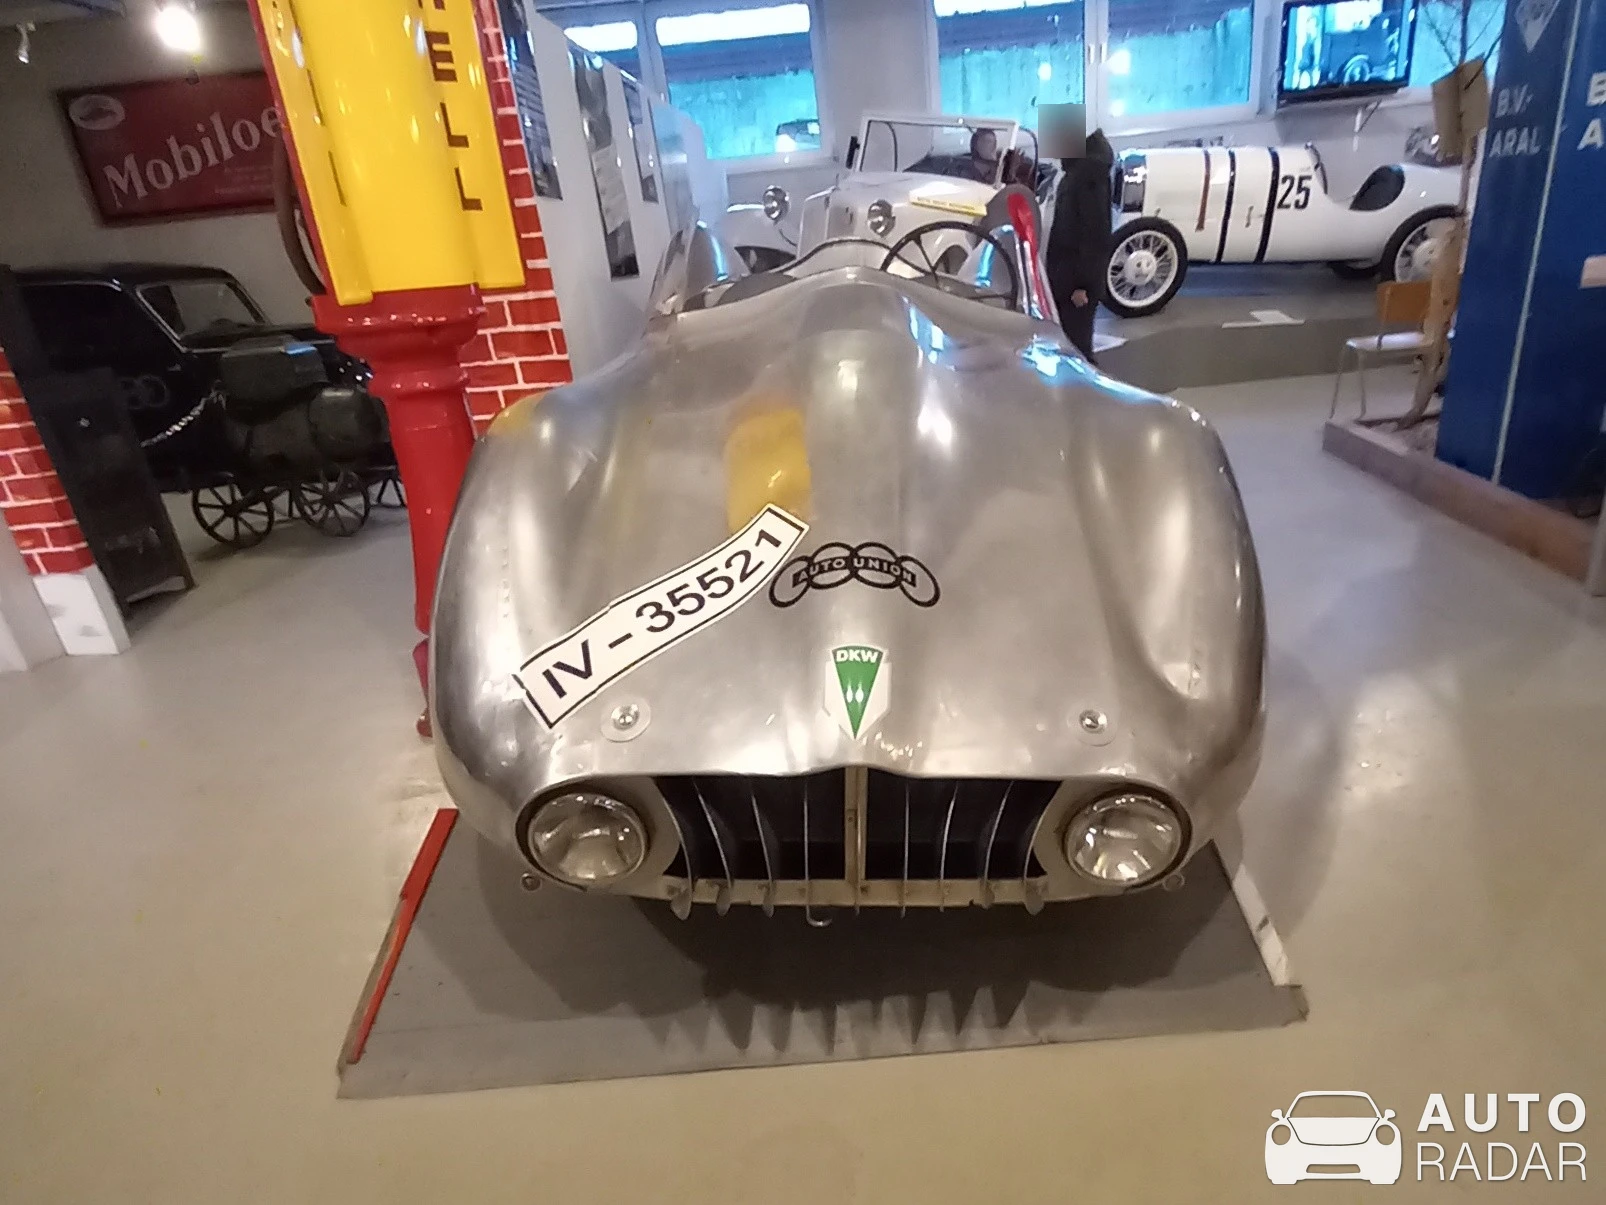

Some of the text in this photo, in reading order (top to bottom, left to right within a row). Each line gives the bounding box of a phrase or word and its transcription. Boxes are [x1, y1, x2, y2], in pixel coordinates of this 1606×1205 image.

[417, 0, 484, 211] ELL
[1489, 126, 1541, 159] ARAL
[1276, 174, 1313, 210] 25
[798, 558, 913, 583] AUTO UNION
[836, 648, 878, 664] DKW
